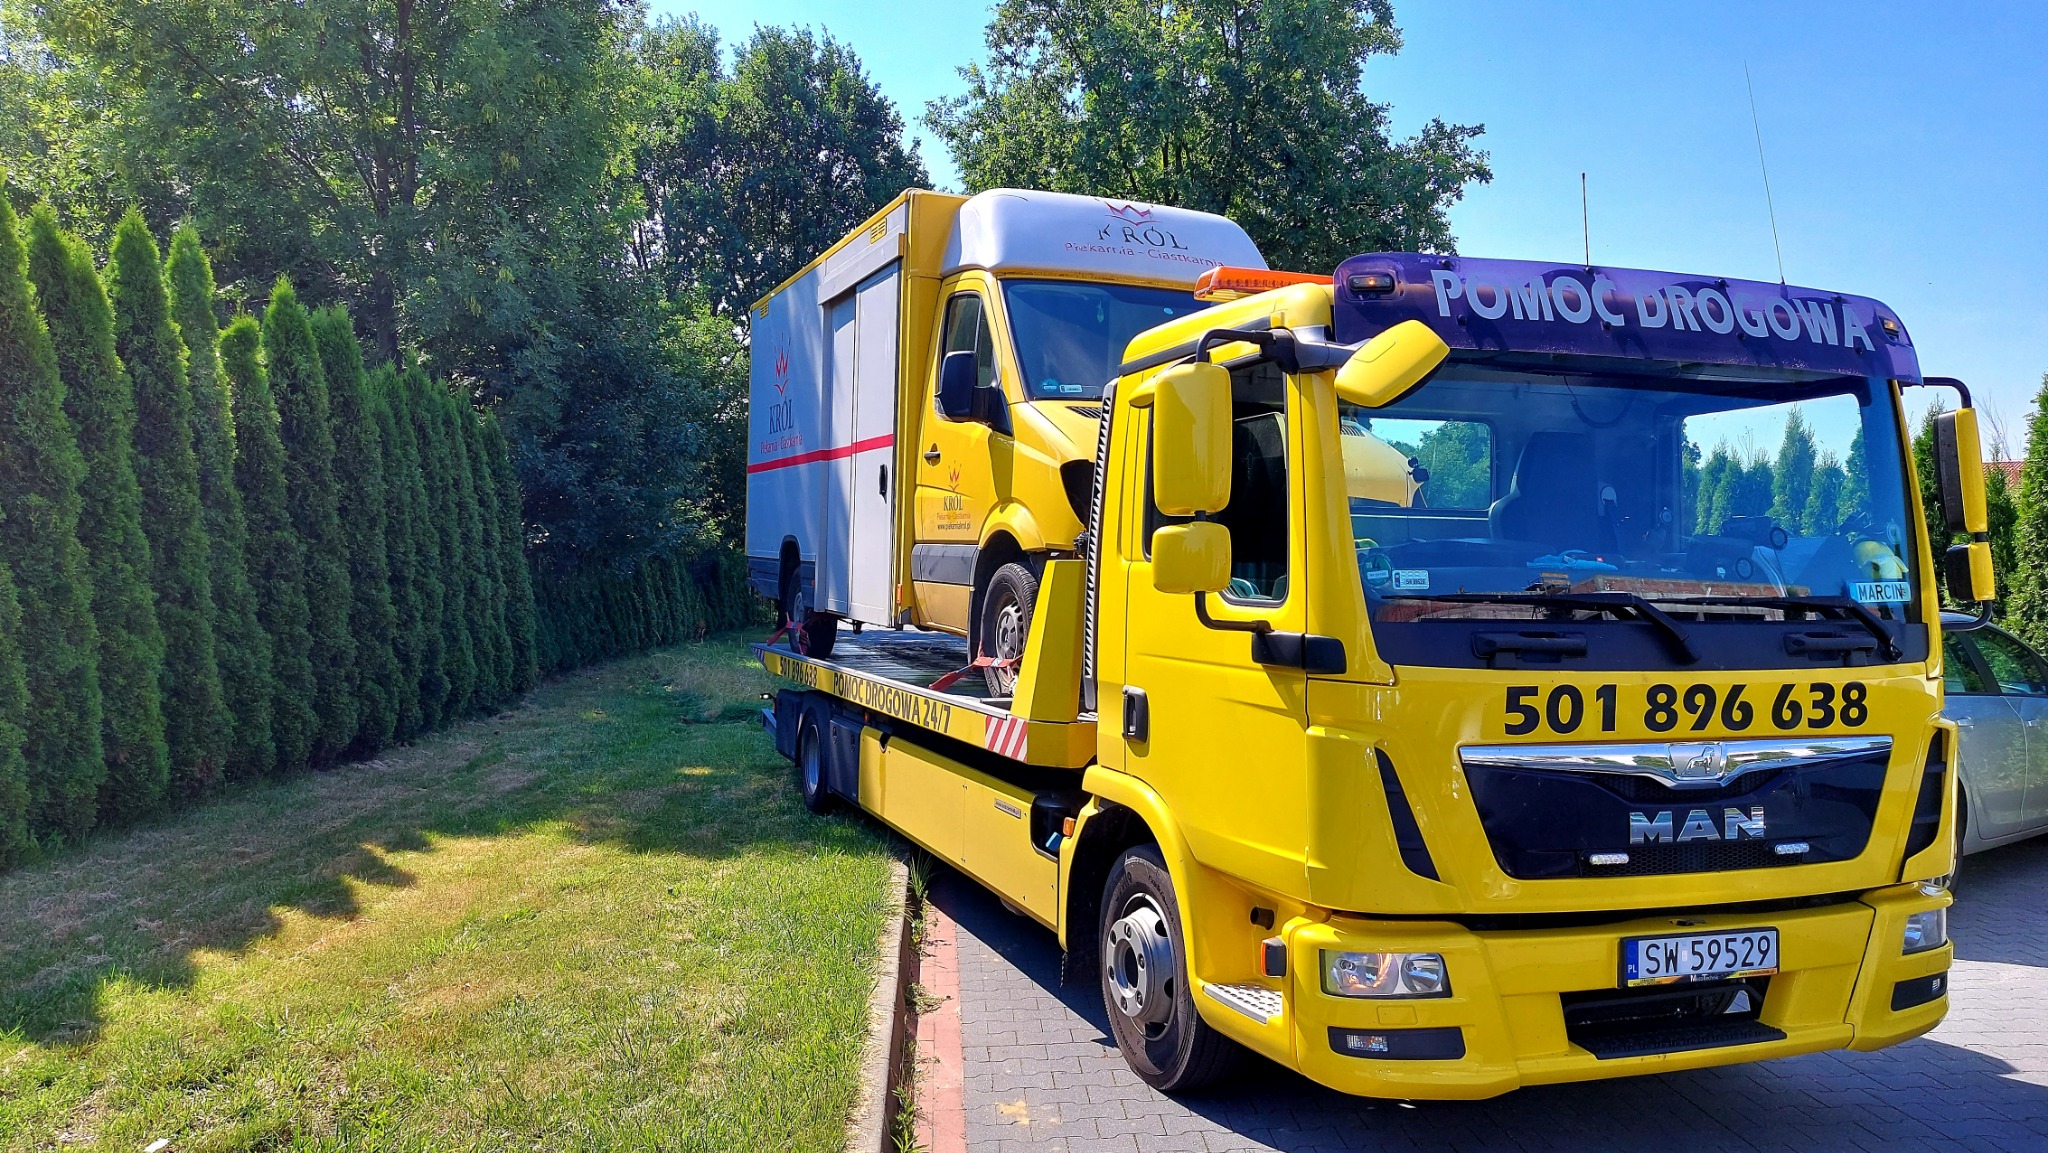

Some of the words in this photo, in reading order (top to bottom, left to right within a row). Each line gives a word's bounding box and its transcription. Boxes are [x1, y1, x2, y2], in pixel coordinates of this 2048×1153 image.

[1430, 269, 1625, 327] POMOC
[1632, 285, 1876, 352] DROGOWA
[769, 396, 795, 435] KRÓL
[943, 494, 964, 511] KRÓL
[1858, 584, 1904, 601] MARCIN
[780, 656, 791, 677] 501
[792, 661, 803, 685] 896
[804, 666, 818, 688] 638
[833, 672, 864, 702] POMOC
[865, 682, 921, 725] DROGOWA
[923, 699, 951, 734] 24/7
[1503, 683, 1618, 736] 501
[1643, 683, 1754, 734] 896
[1770, 681, 1869, 731] 638
[1629, 806, 1766, 845] MAN
[1627, 963, 1638, 974] PL
[1645, 941, 1679, 975] SW
[1690, 935, 1771, 972] 59529
